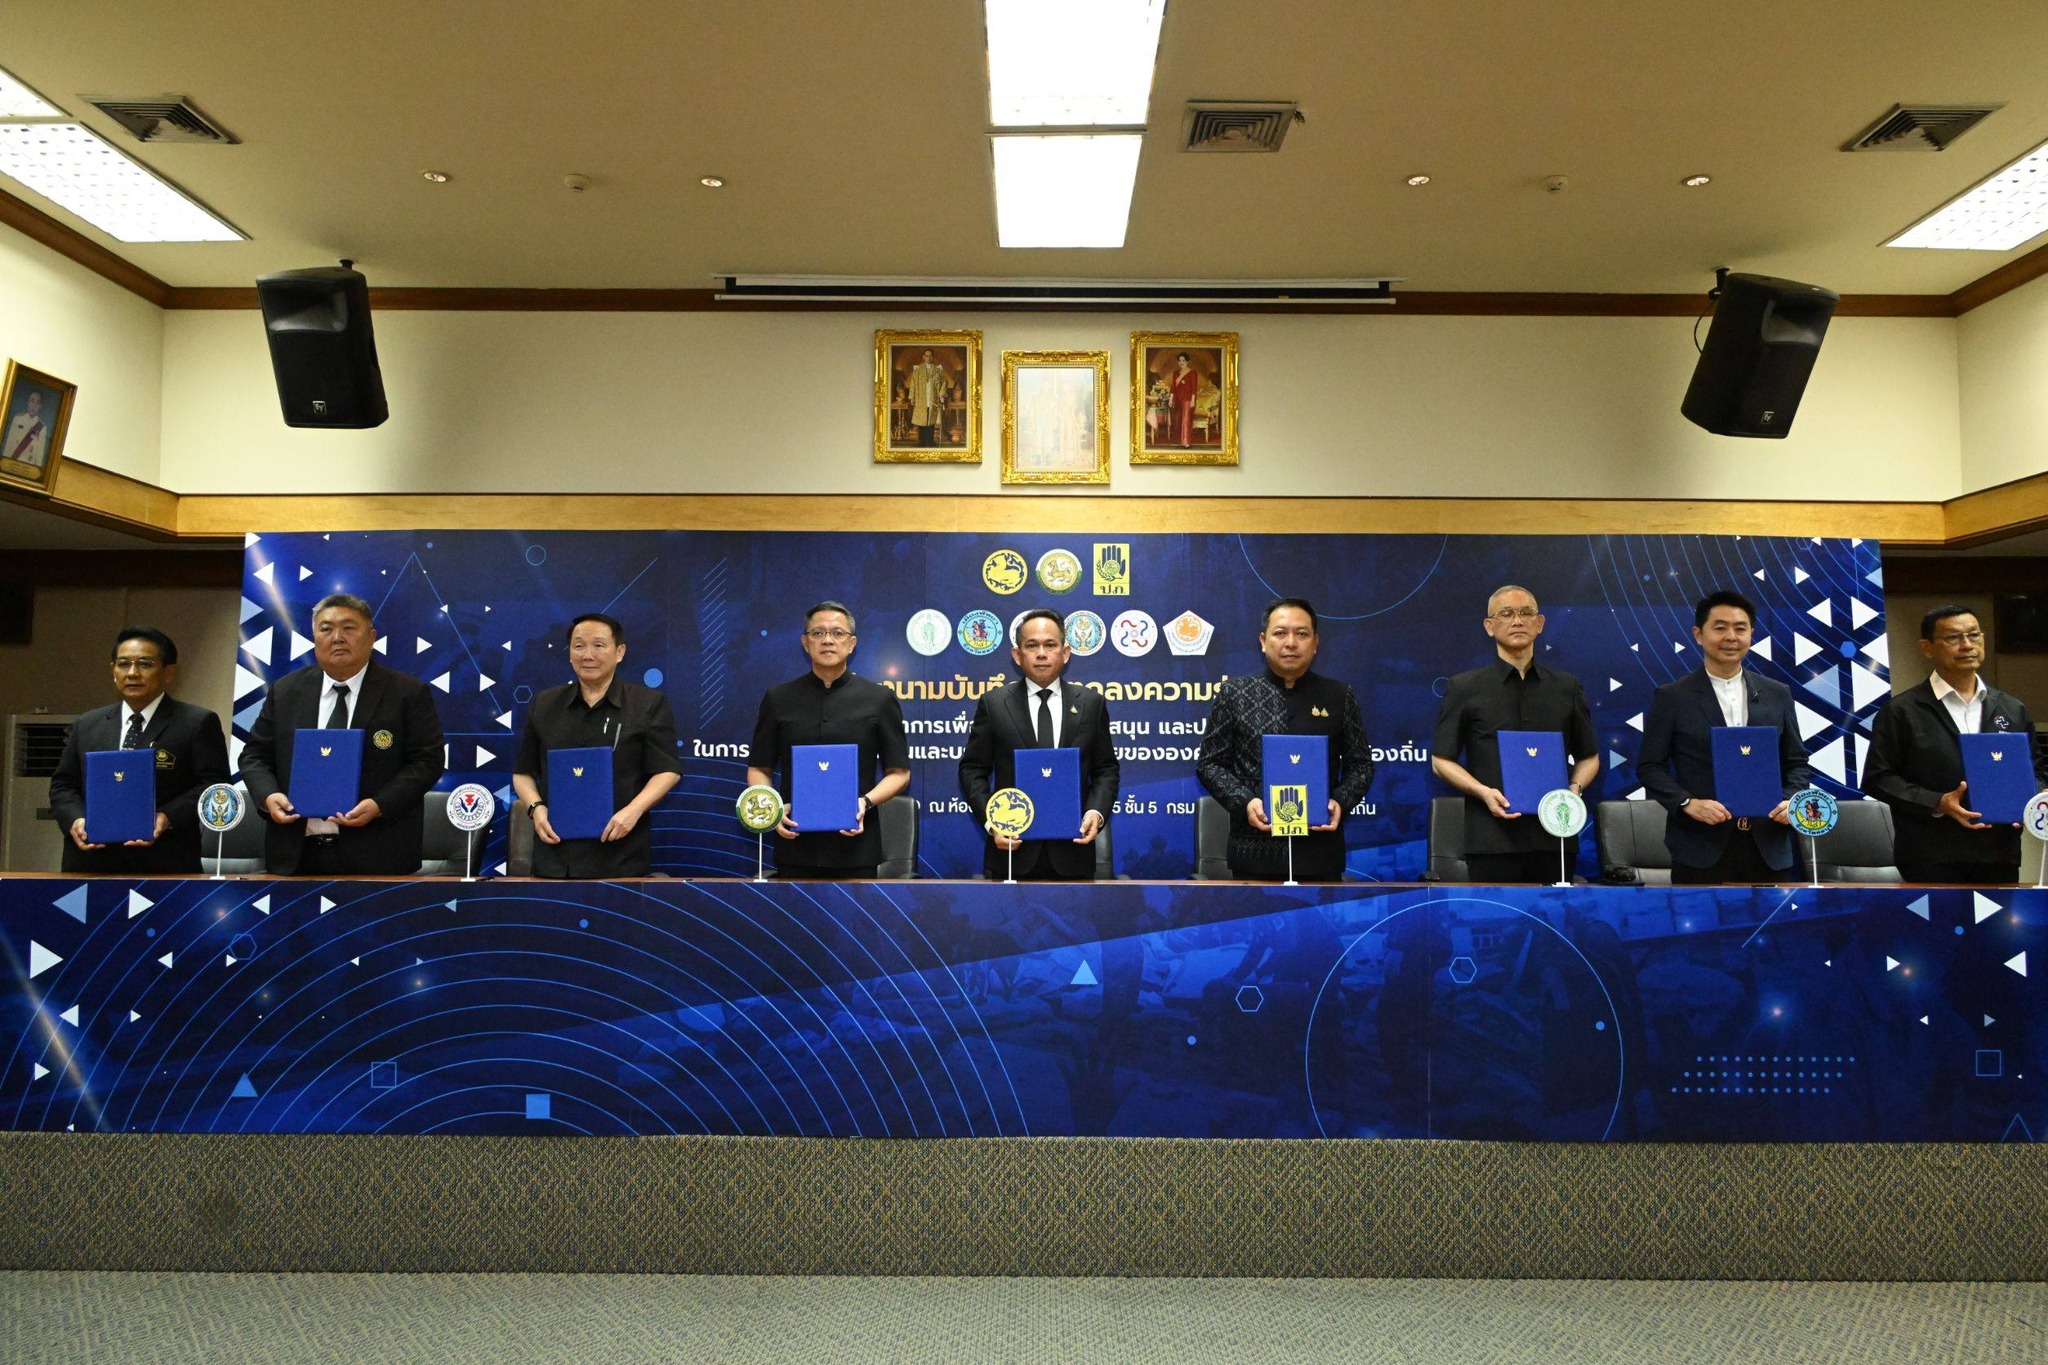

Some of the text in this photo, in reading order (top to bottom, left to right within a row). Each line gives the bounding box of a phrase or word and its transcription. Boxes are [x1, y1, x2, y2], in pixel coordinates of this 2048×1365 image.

[693, 739, 750, 758] ในการ
[1125, 794, 1144, 814] ชั้น
[1148, 801, 1157, 814] 5
[1166, 802, 1195, 814] กรม
